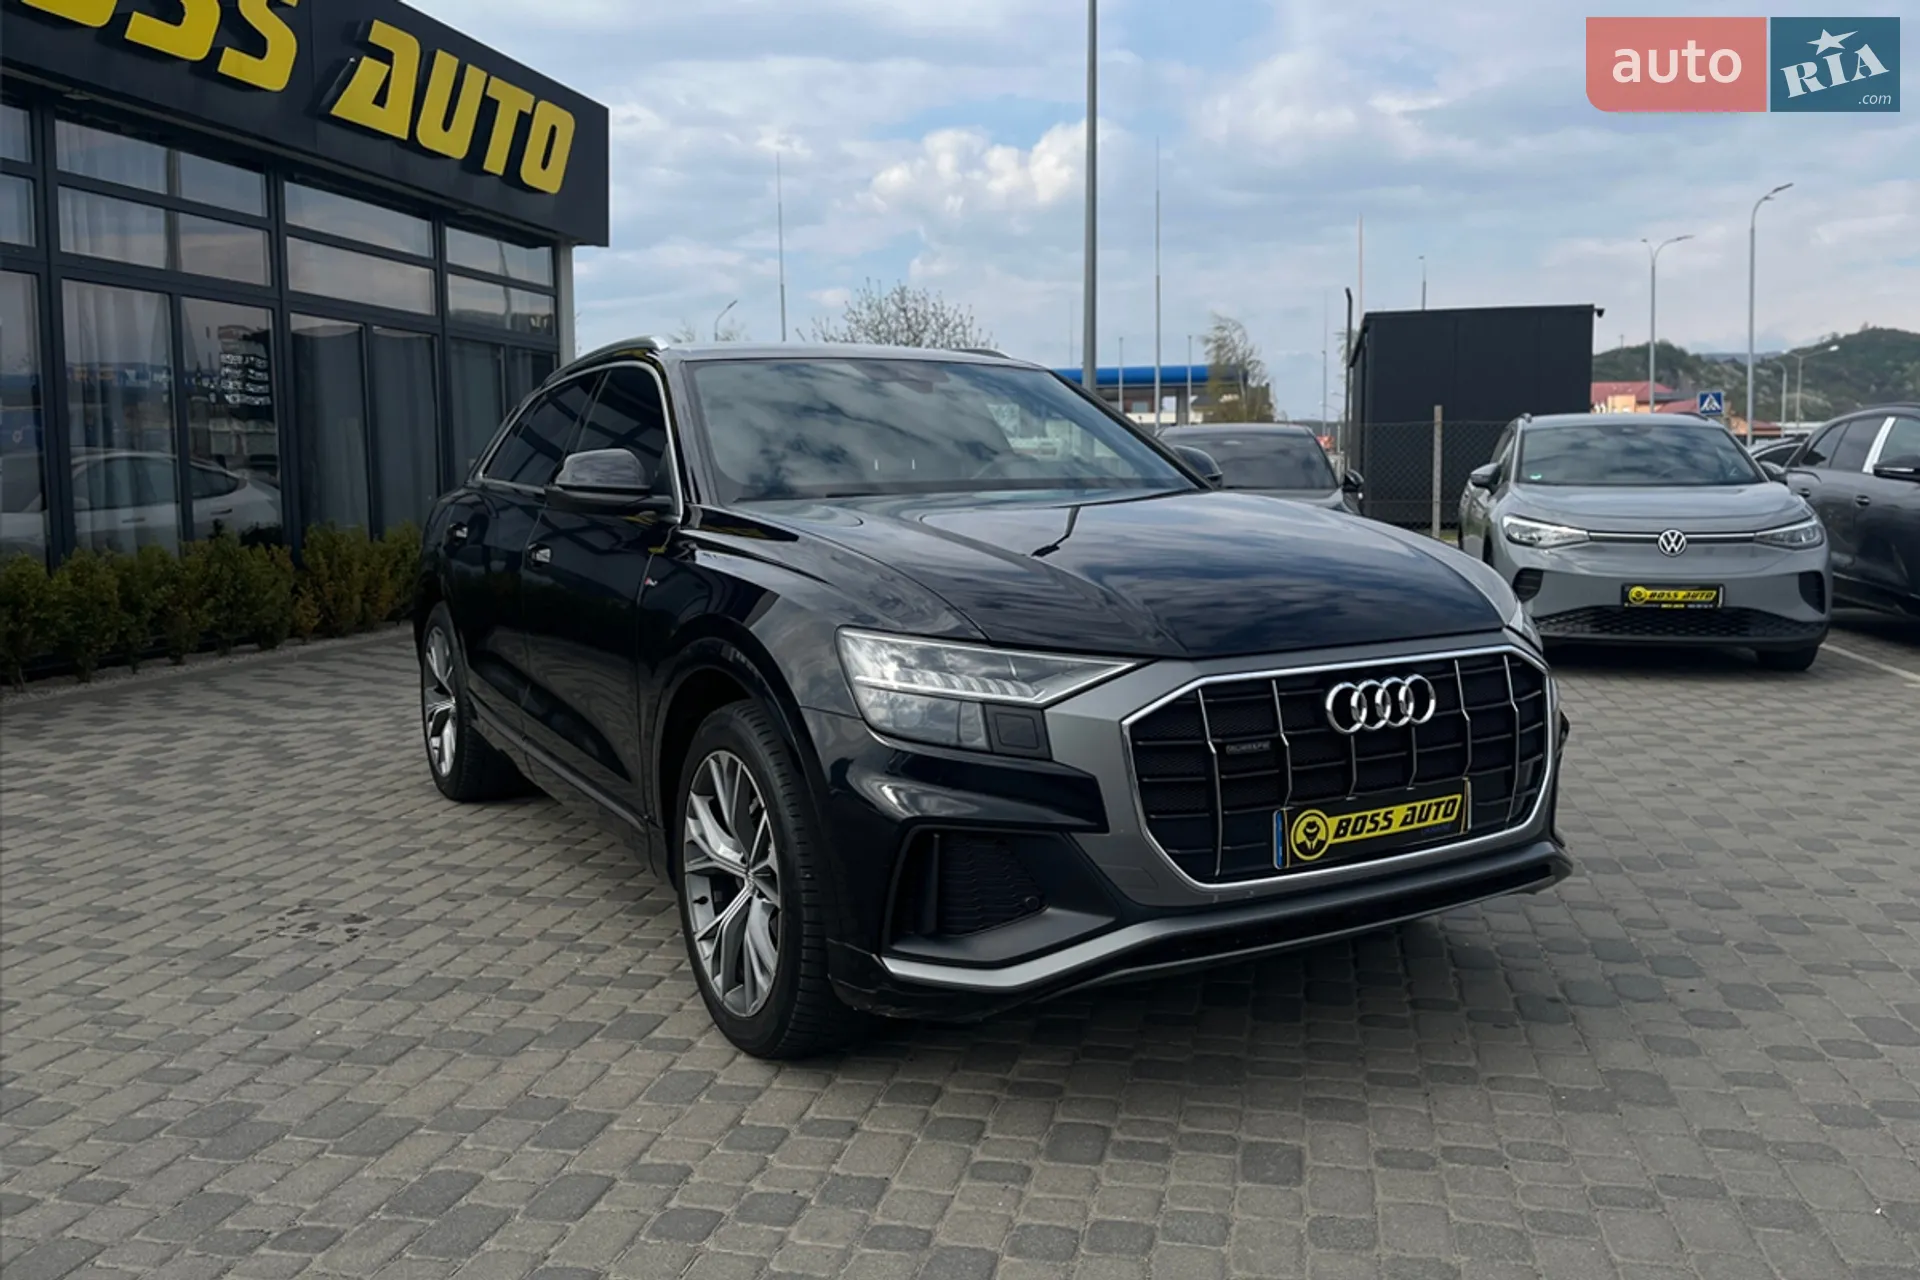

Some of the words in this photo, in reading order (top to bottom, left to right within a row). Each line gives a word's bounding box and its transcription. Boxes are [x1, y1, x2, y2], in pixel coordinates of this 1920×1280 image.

[329, 19, 576, 195] AUTO
[1333, 810, 1395, 839] BOSS
[1399, 799, 1458, 828] AUTO
